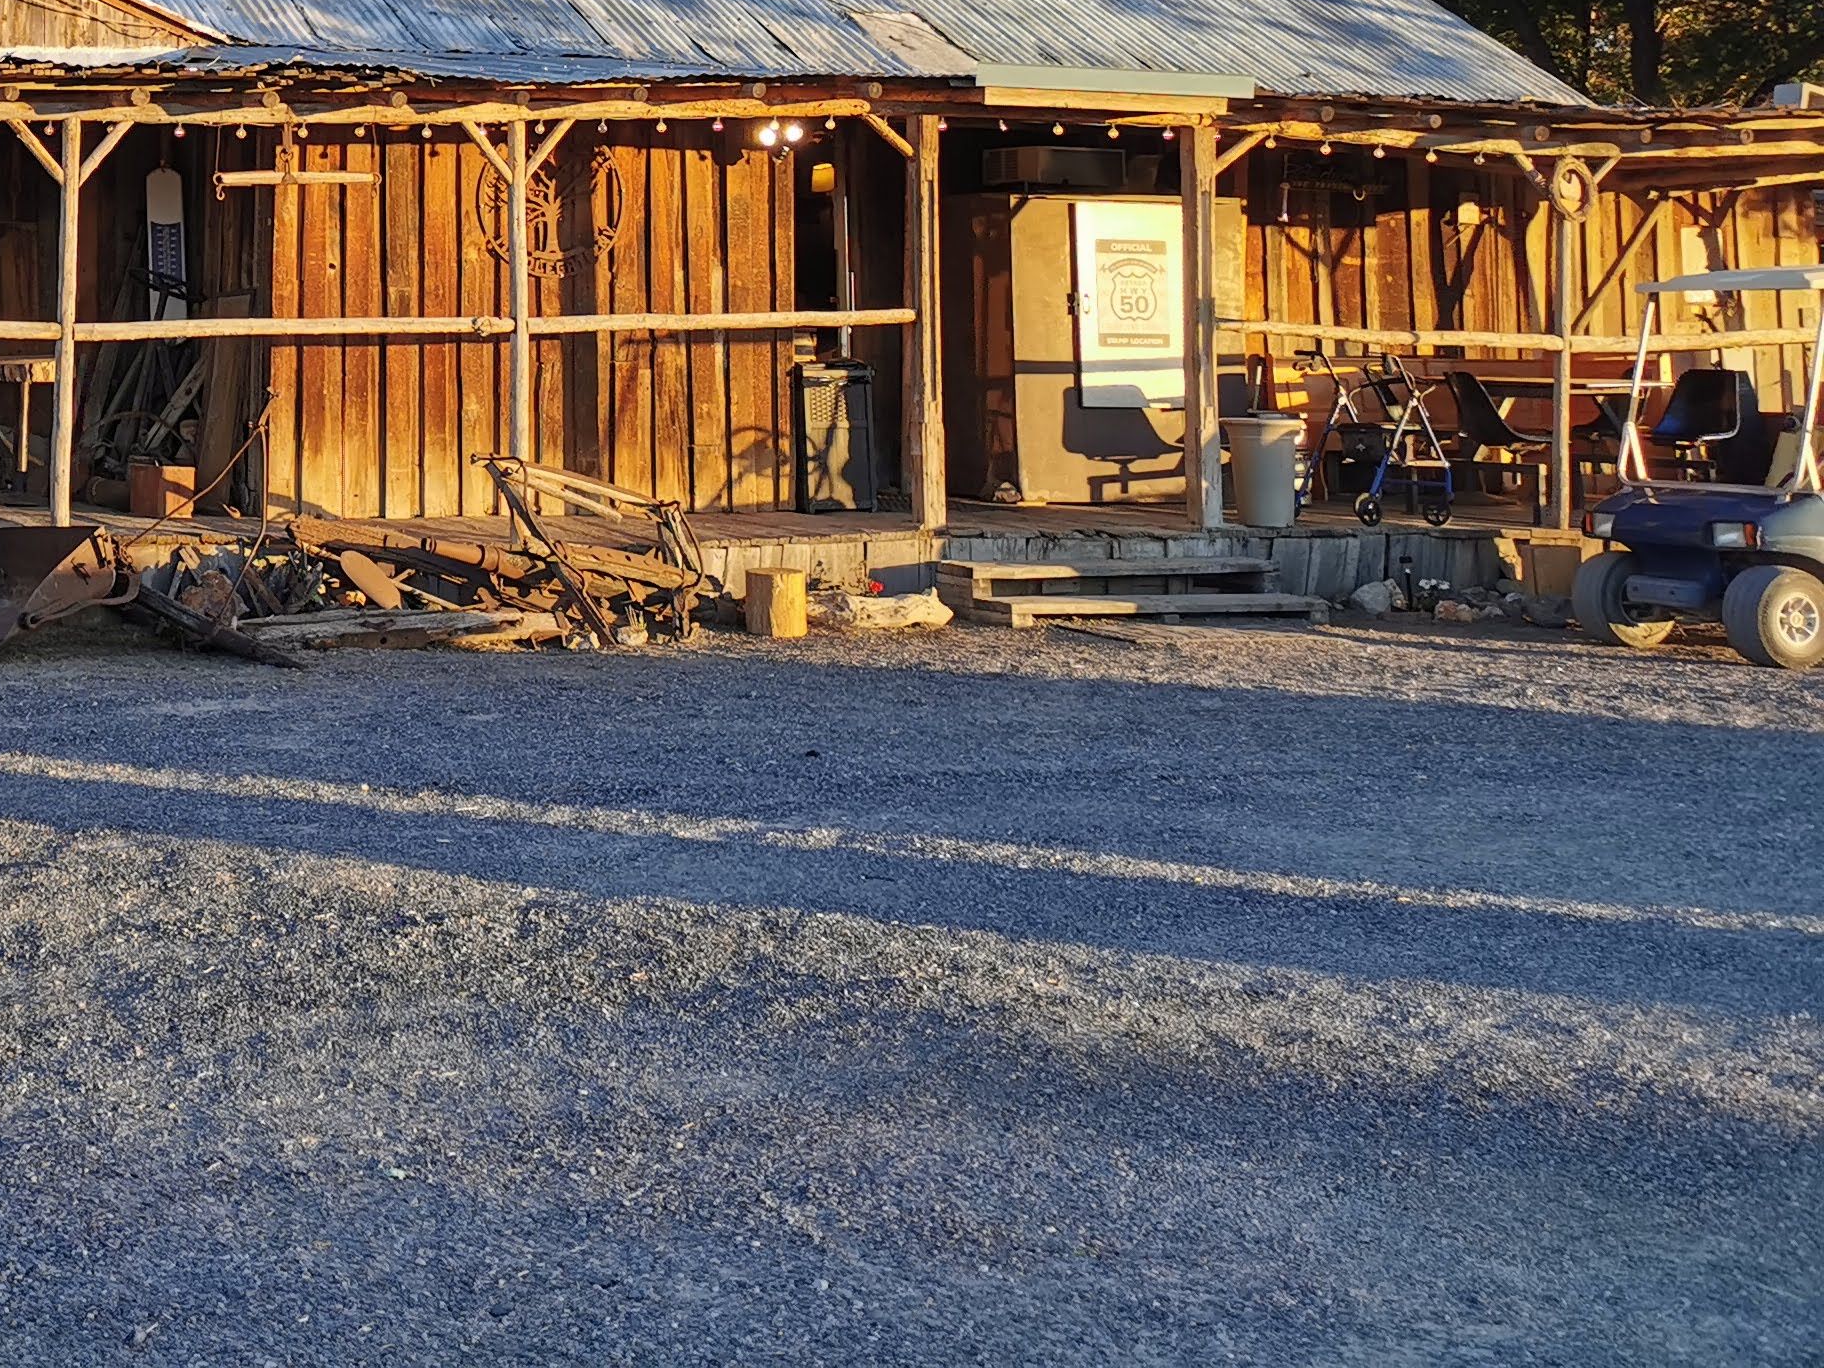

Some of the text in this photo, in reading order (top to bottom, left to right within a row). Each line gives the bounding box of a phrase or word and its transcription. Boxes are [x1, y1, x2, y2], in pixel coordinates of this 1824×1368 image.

[1110, 243, 1153, 253] OFFICIAL
[1120, 296, 1149, 314] 50
[1106, 336, 1163, 345] STAMP LOCATION
